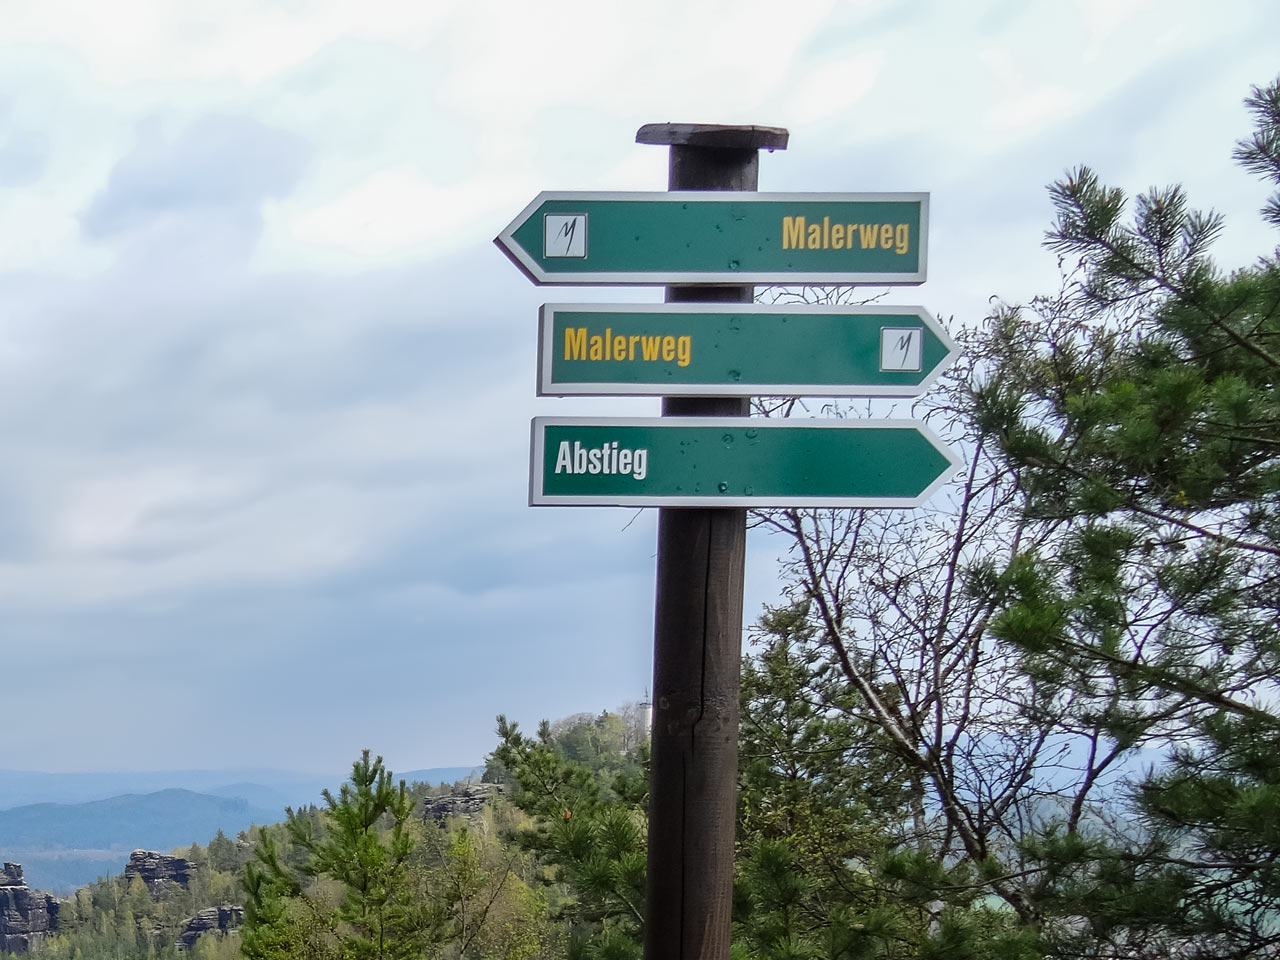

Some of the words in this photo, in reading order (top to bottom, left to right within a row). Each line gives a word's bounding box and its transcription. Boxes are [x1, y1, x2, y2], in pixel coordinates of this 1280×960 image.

[782, 216, 909, 255] Malerweg
[564, 327, 692, 367] Malerweg
[554, 441, 648, 480] Abstieg
